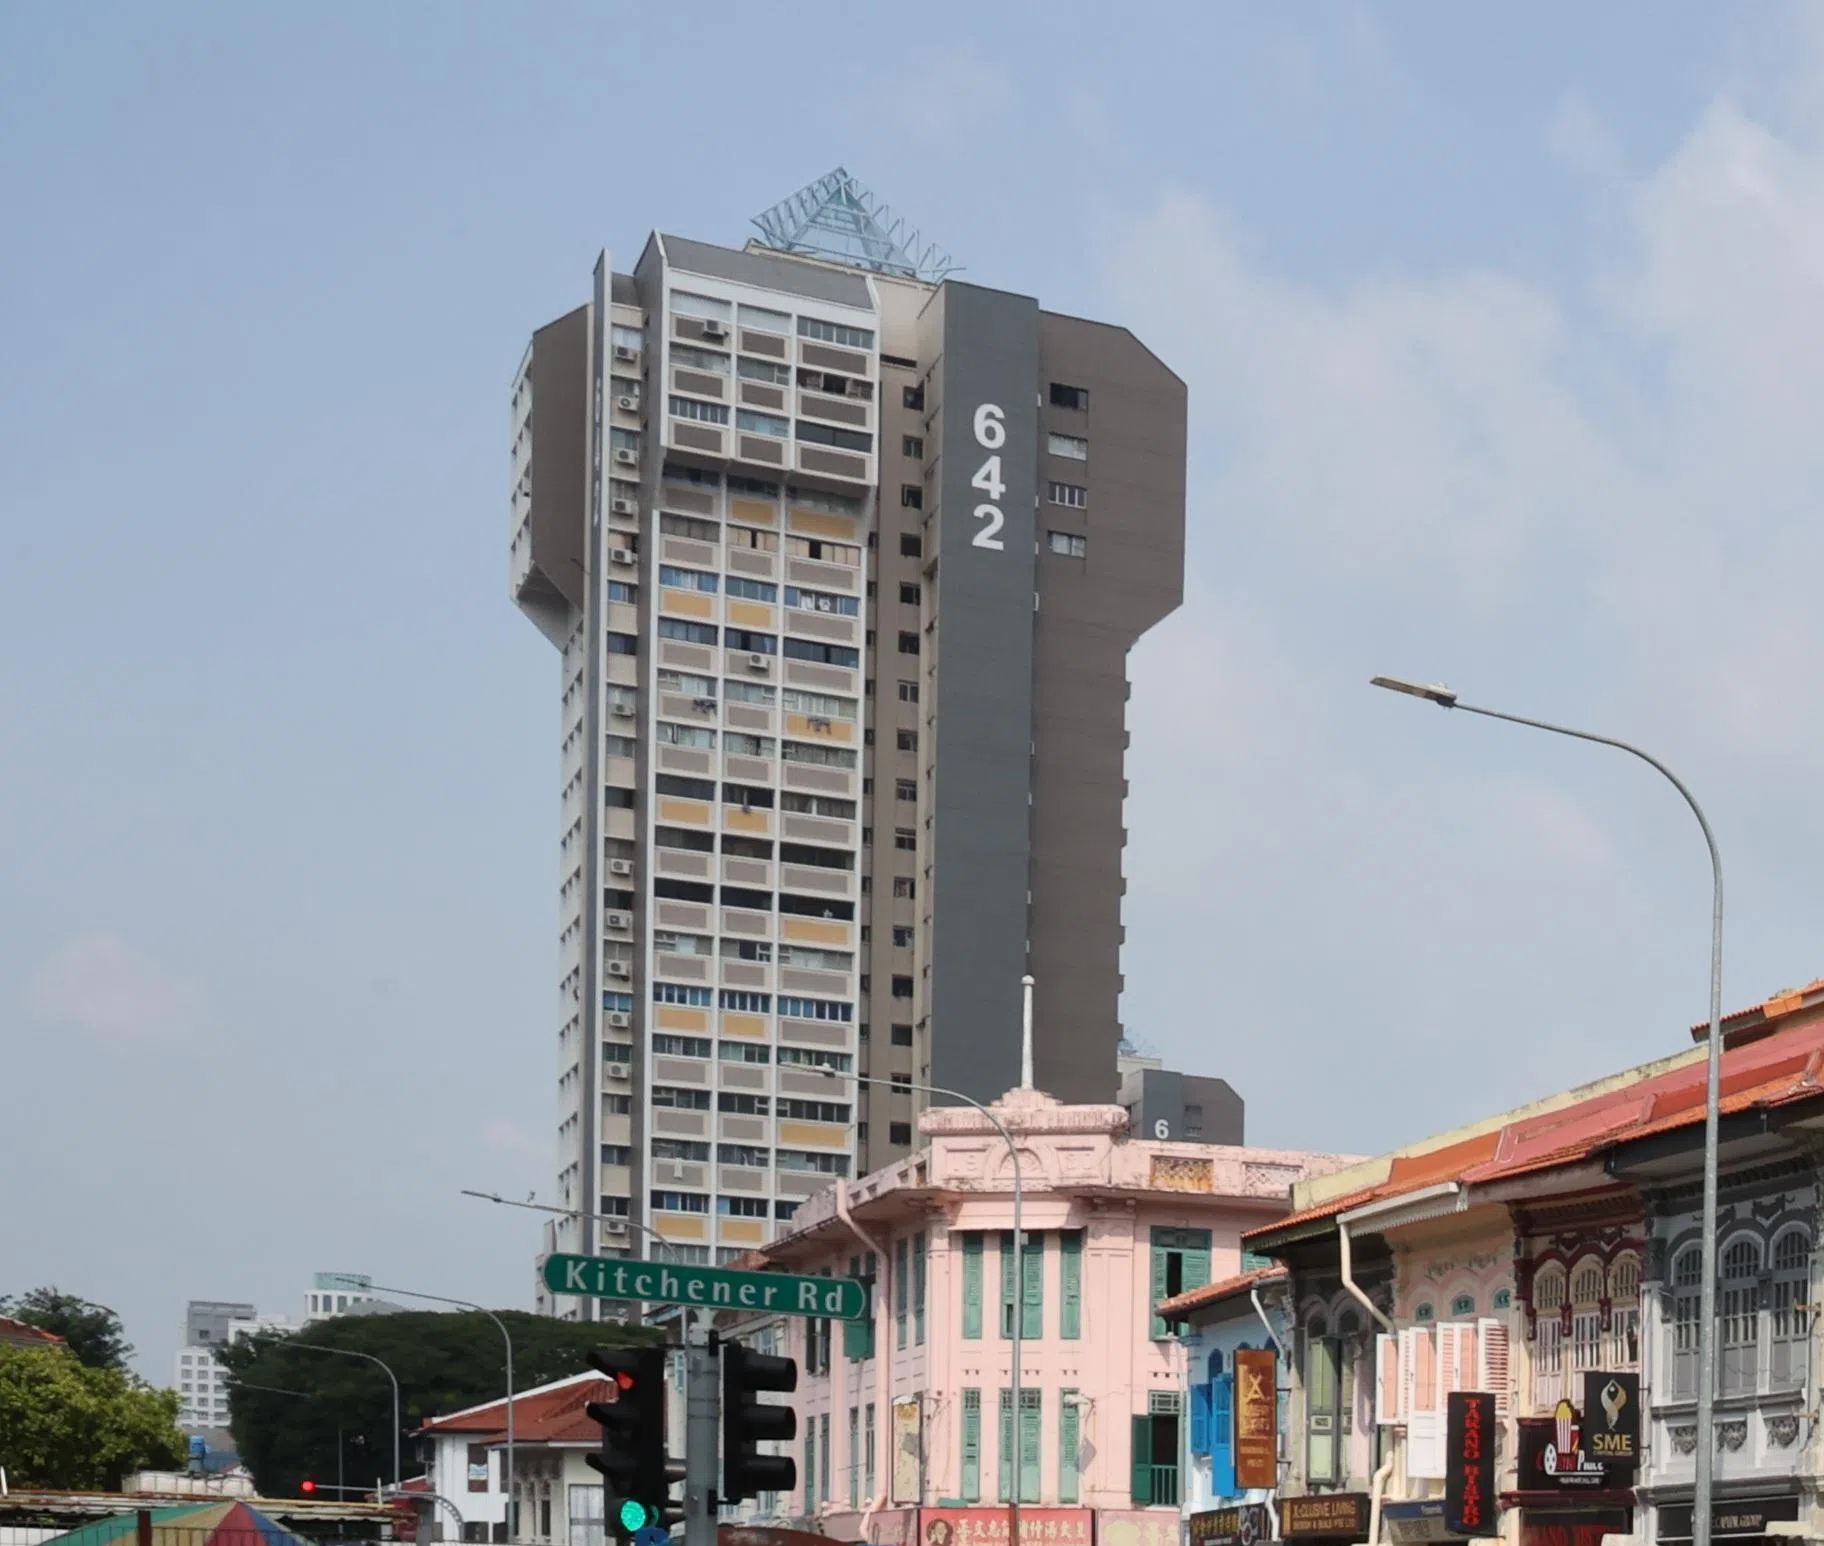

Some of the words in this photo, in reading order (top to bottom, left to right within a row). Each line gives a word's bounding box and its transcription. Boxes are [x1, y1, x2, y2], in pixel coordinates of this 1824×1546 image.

[971, 403, 1006, 550] 642
[566, 1260, 777, 1306] Kitchener
[798, 1281, 843, 1313] Rd
[1593, 1433, 1632, 1450] SME
